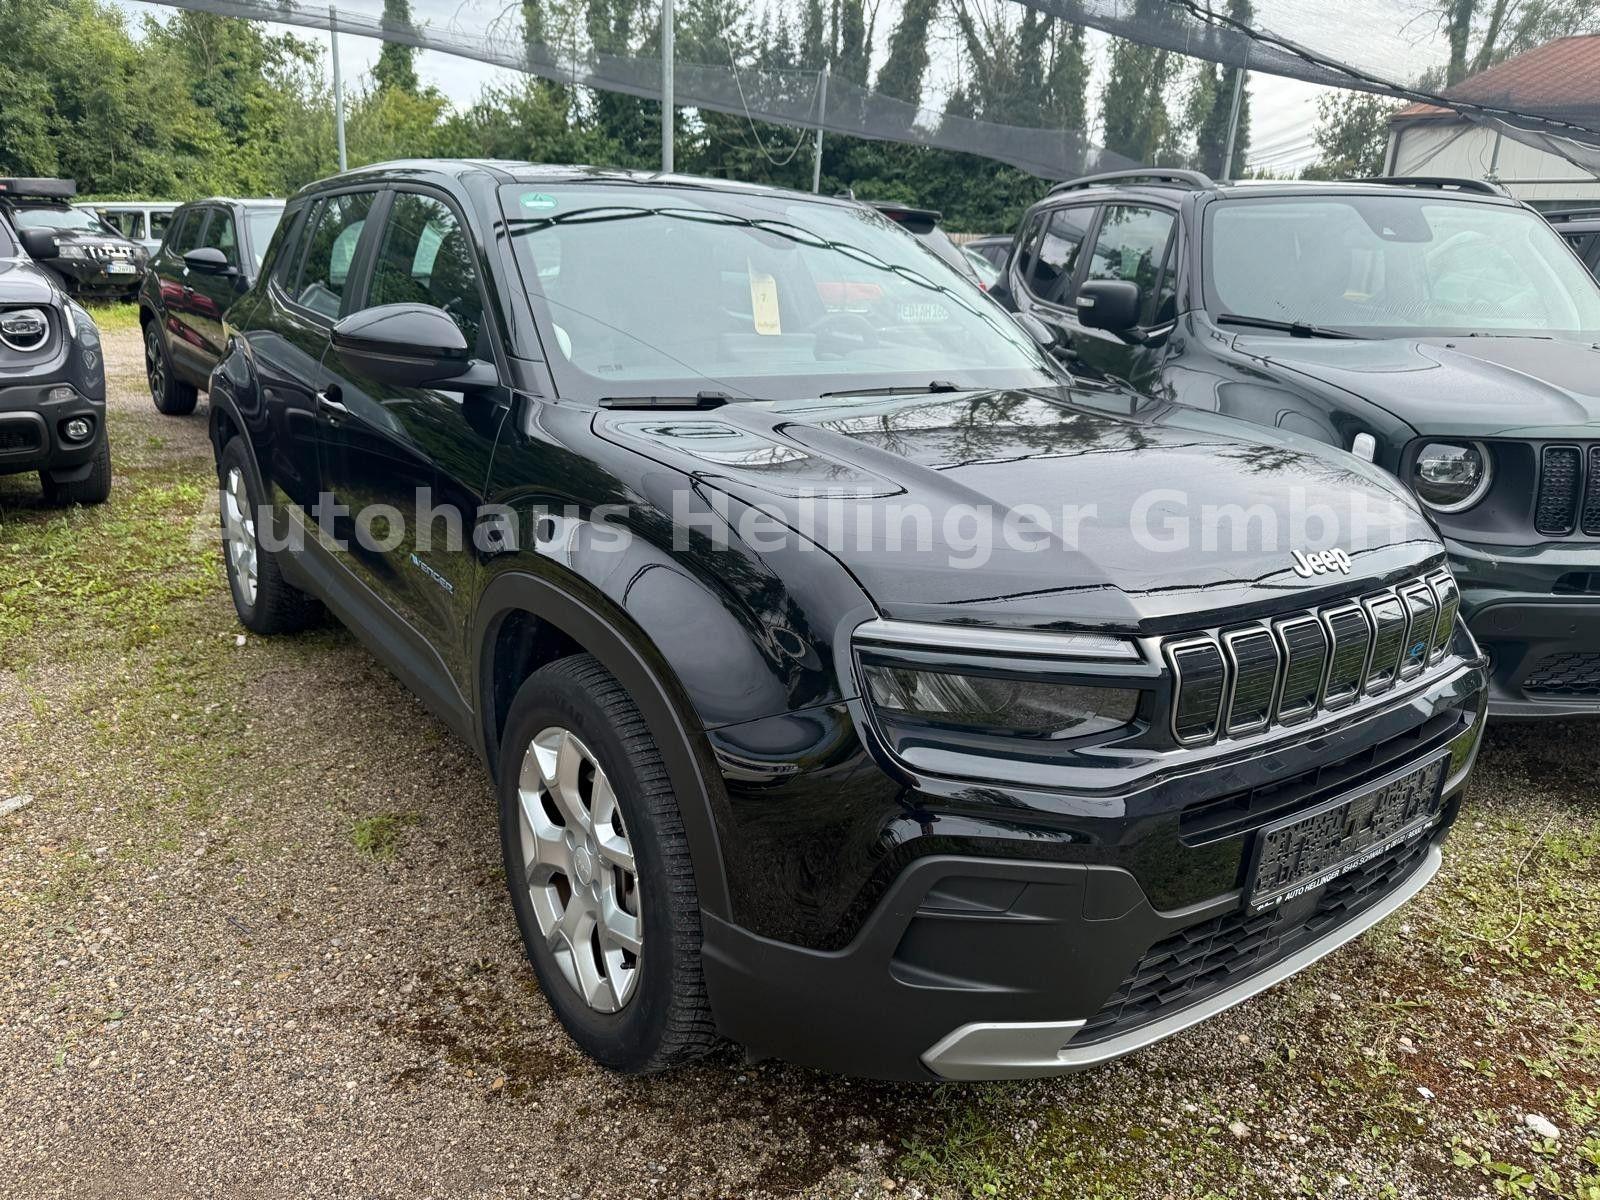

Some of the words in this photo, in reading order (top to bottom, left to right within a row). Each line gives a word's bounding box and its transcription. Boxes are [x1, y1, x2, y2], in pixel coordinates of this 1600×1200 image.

[1291, 547, 1352, 578] Jeep
[1284, 888, 1304, 901] AUTO
[1304, 869, 1340, 893] HELLINGER
